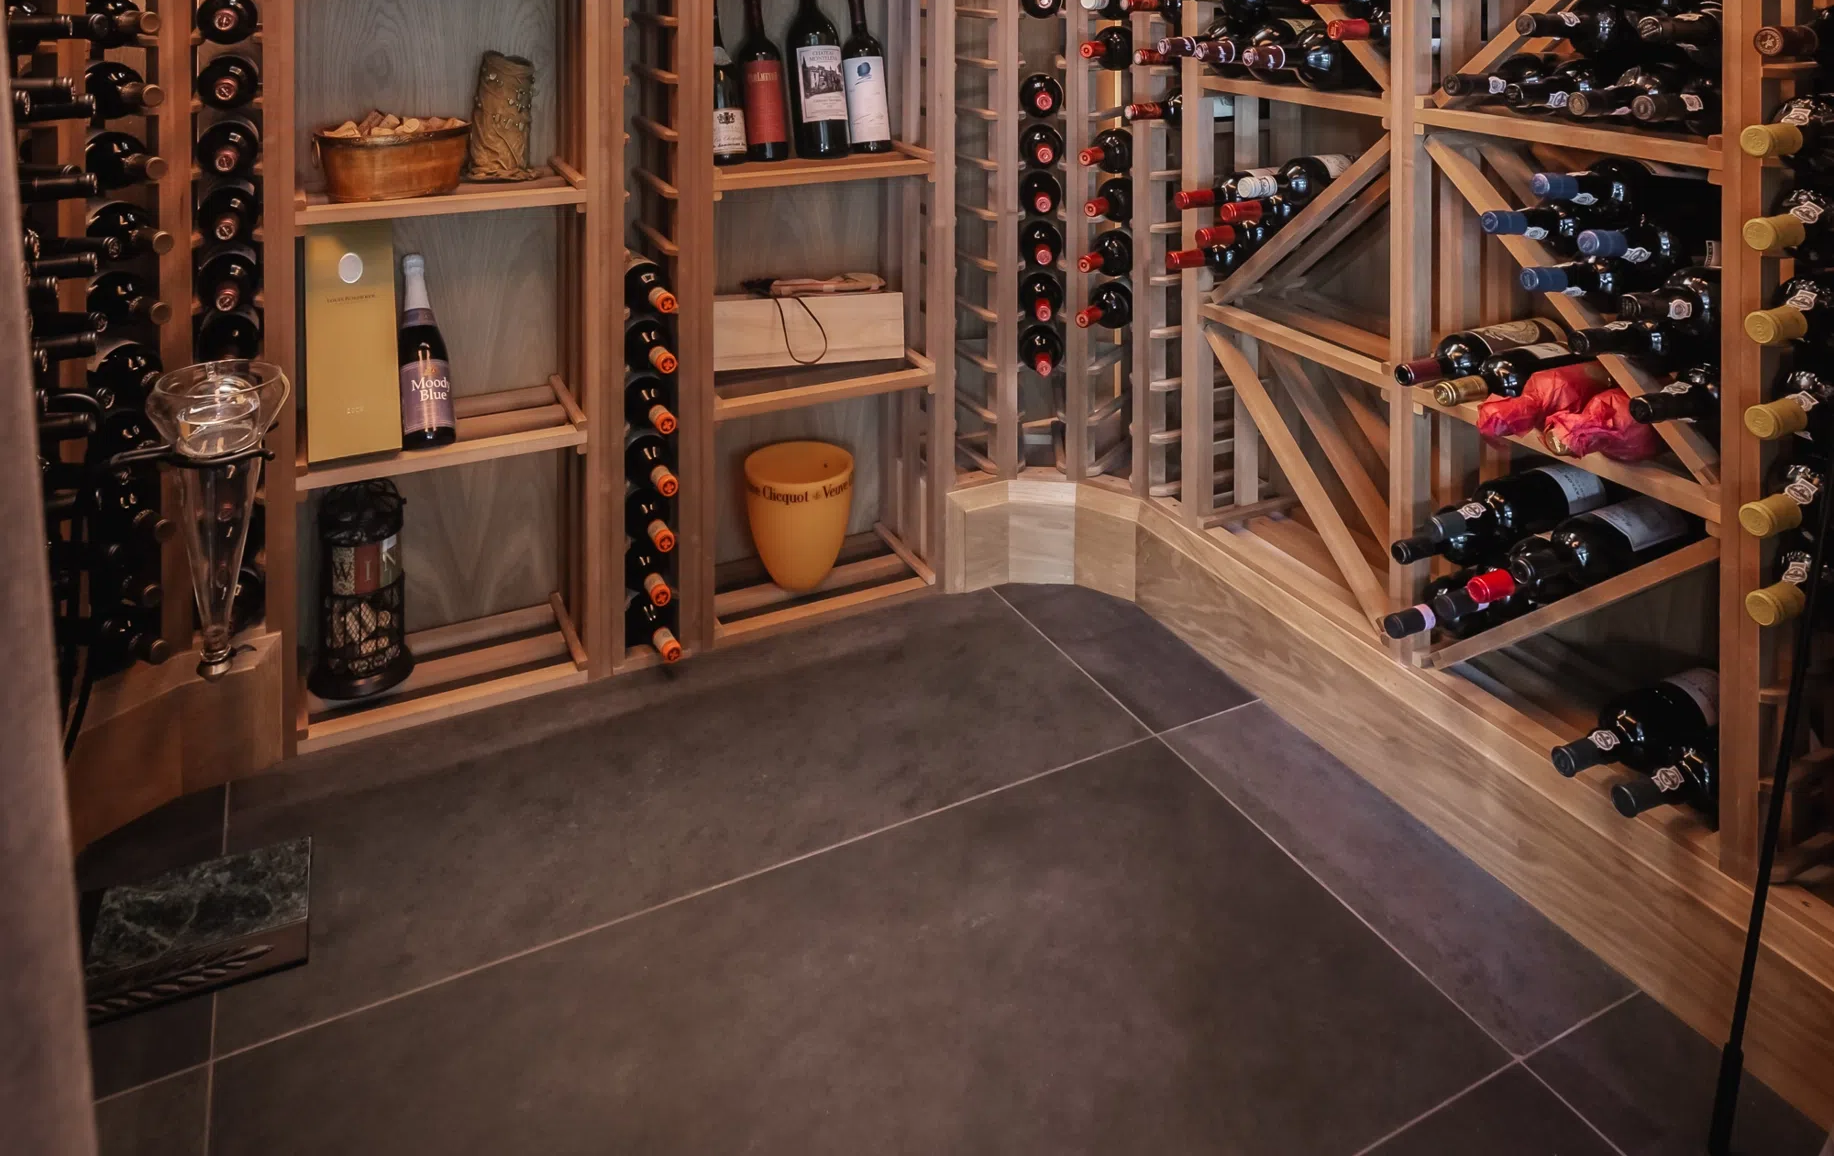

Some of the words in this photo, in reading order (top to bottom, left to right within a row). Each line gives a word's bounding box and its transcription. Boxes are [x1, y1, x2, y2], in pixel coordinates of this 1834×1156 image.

[411, 376, 450, 392] Moody
[419, 389, 447, 402] Blue
[762, 485, 808, 506] Clicquot
[822, 480, 848, 499] Veuve
